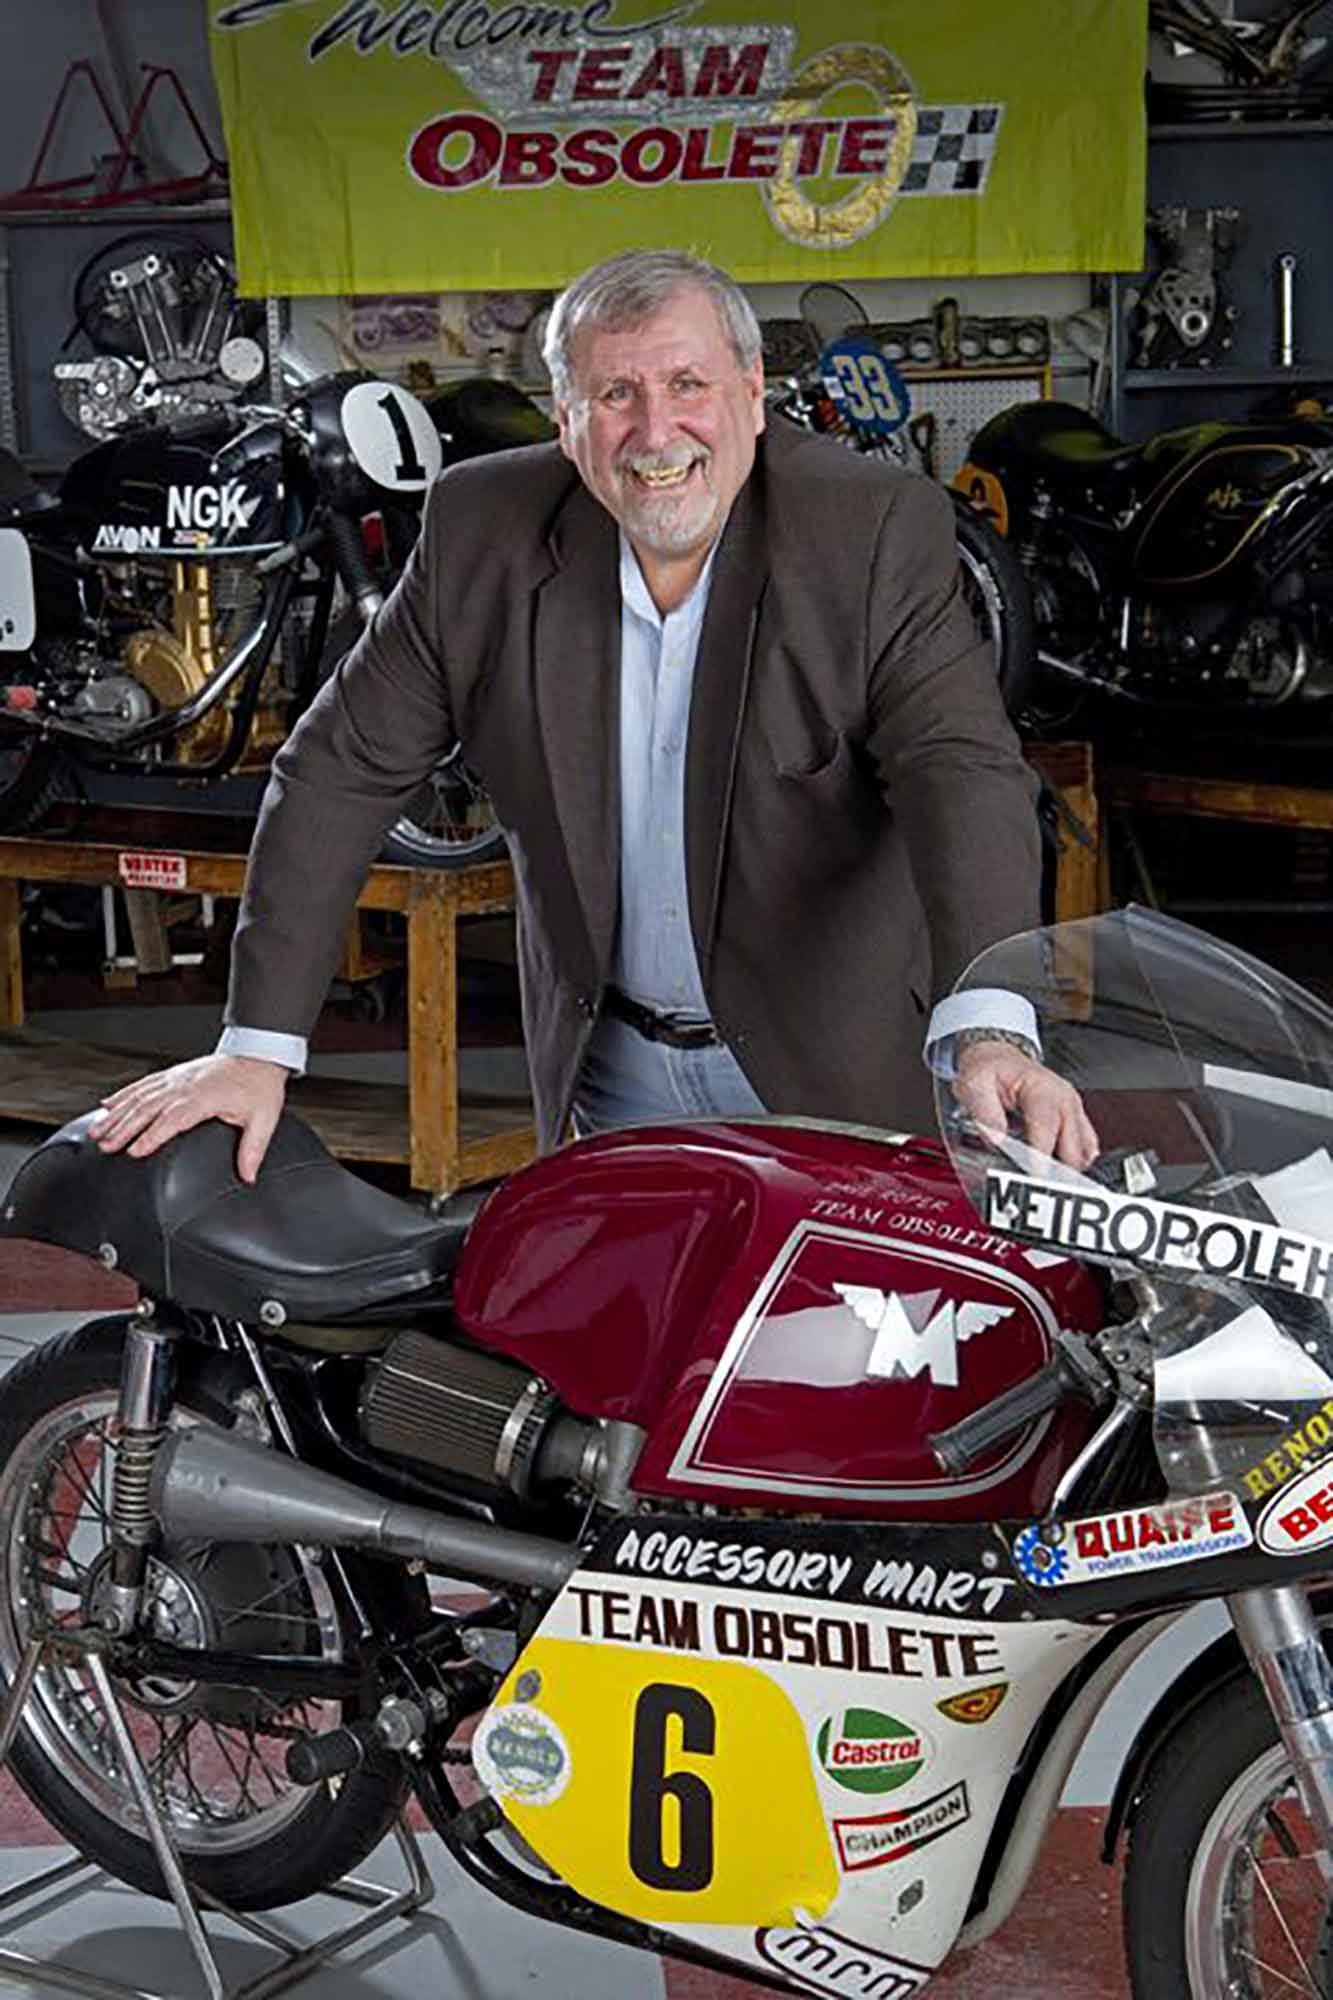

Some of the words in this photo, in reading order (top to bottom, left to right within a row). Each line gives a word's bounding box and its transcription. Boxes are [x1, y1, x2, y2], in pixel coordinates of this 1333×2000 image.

[527, 43, 769, 102] TEAM
[408, 112, 898, 189] OBSOLETE
[831, 355, 901, 420] 33
[378, 391, 426, 481] 1
[166, 484, 251, 529] NGK
[94, 524, 161, 553] AVON
[810, 1198, 884, 1226] TEAM
[888, 1213, 1018, 1259] OBSOLETE
[1278, 1482, 1333, 1542] BE
[615, 1529, 853, 1594] ACCESSORY
[863, 1560, 1016, 1615] MART
[567, 1586, 701, 1651] TEAM
[713, 1604, 1006, 1678] OBSOLETE
[832, 1738, 922, 1766] Castrol
[628, 1682, 717, 1892] 6
[845, 1796, 962, 1852] CHAMPION
